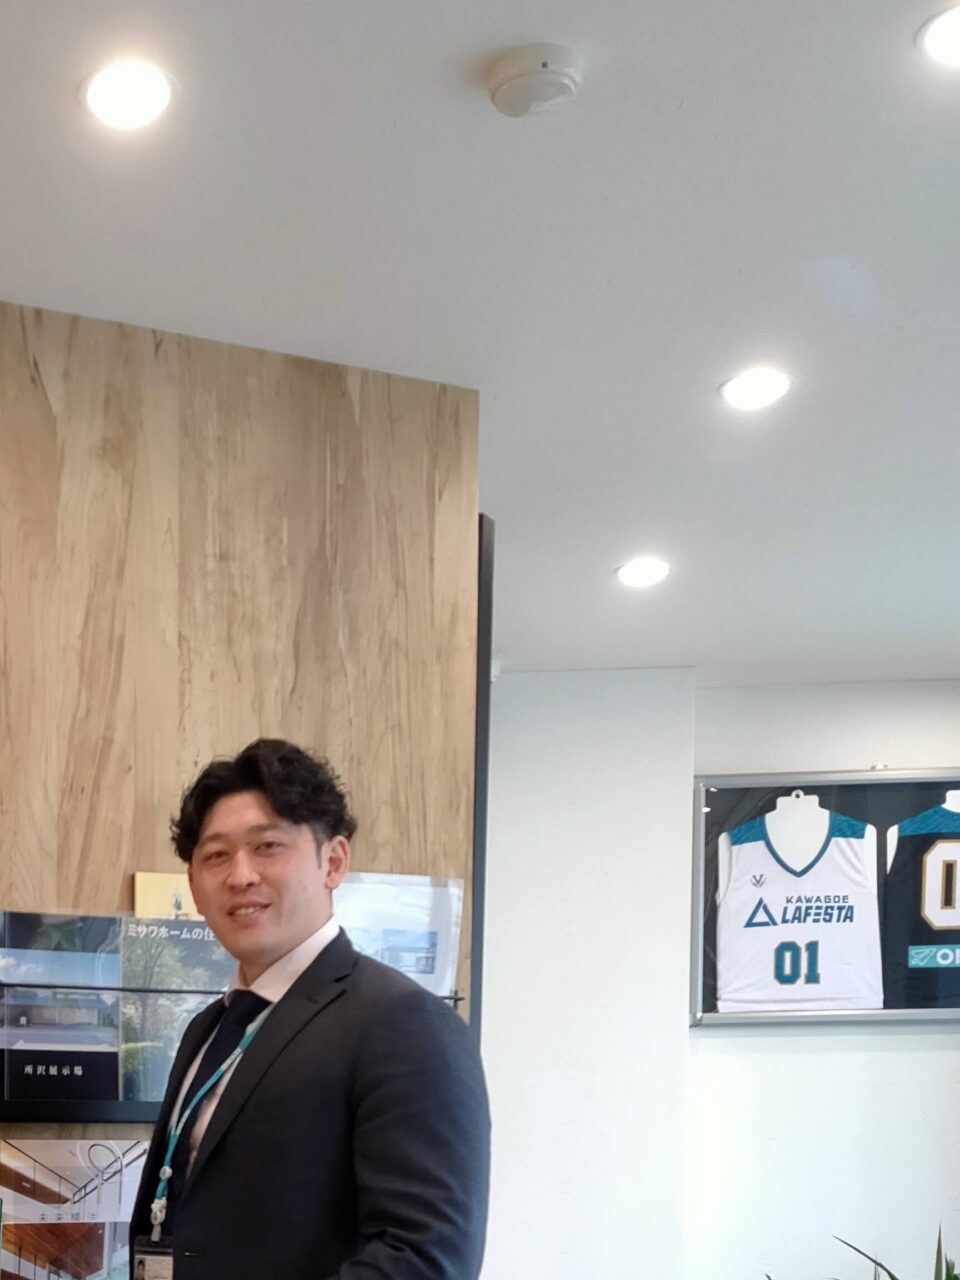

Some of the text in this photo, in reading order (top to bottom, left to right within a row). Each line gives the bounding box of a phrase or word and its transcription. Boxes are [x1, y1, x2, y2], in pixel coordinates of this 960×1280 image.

[786, 895, 849, 904] KAWAGOE
[781, 905, 854, 924] LAFESTA
[774, 940, 821, 985] 01
